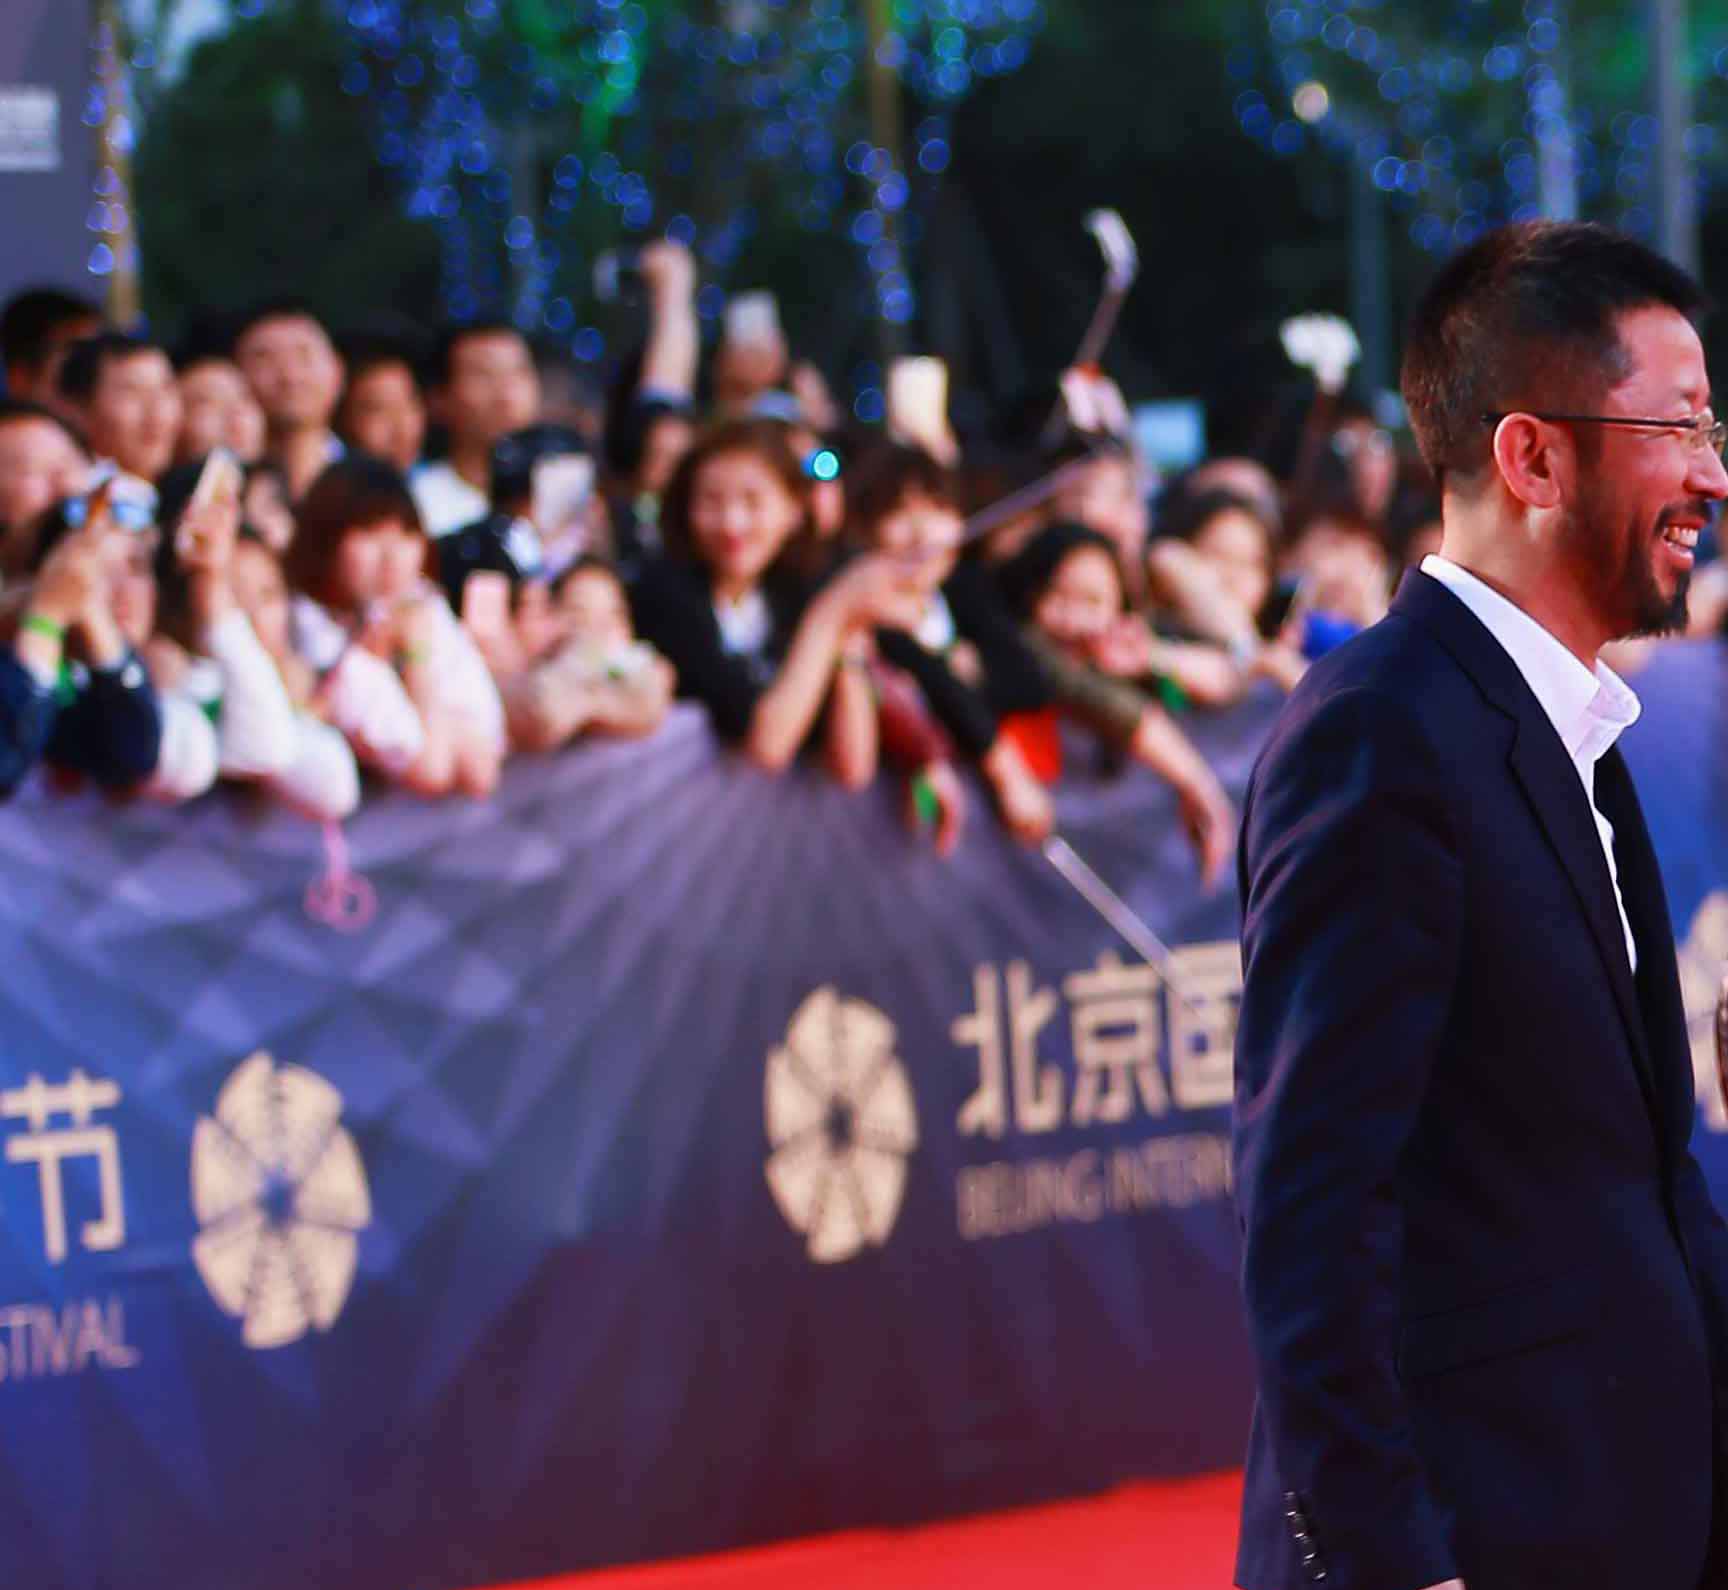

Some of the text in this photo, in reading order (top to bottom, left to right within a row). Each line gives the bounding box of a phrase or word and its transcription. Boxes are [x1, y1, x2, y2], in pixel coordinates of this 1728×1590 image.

[951, 939, 1242, 1137] 北京国
[0, 1068, 124, 1263] 节
